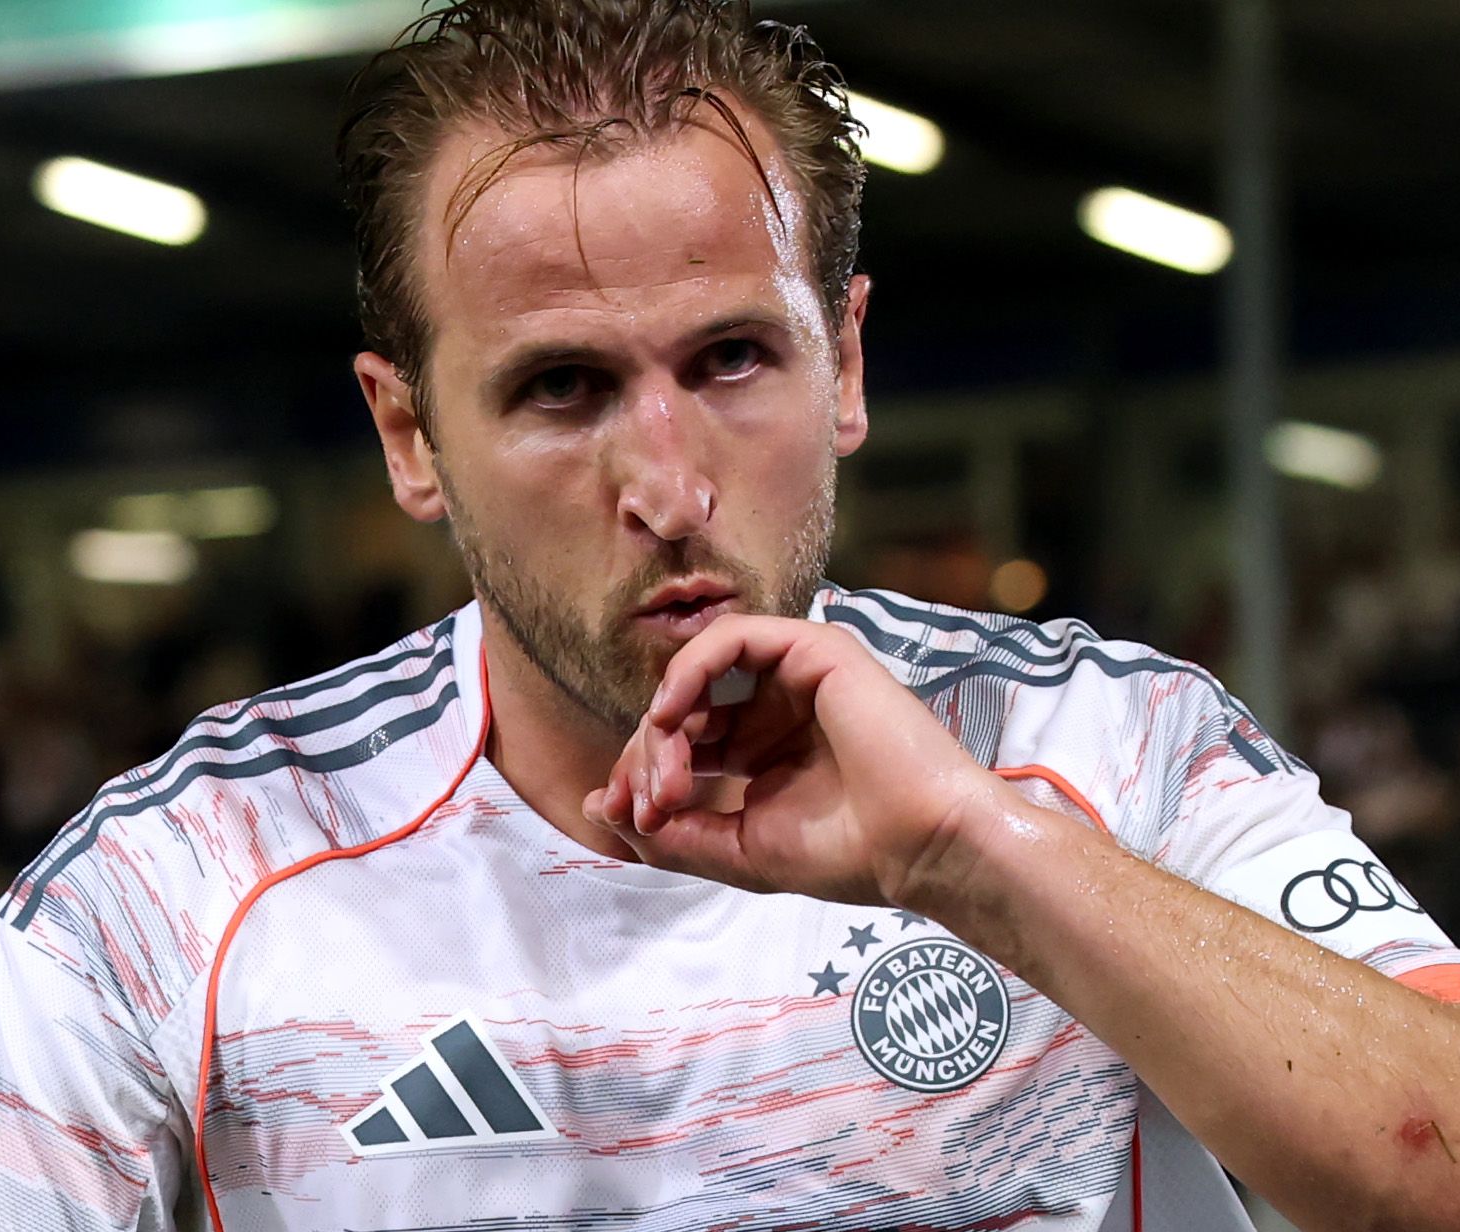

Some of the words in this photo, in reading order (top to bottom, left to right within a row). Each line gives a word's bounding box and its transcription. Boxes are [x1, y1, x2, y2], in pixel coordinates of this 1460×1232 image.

[862, 978, 889, 1012] FC
[887, 947, 993, 995] BAYERN
[872, 1019, 1000, 1081] MÜNCHEN
